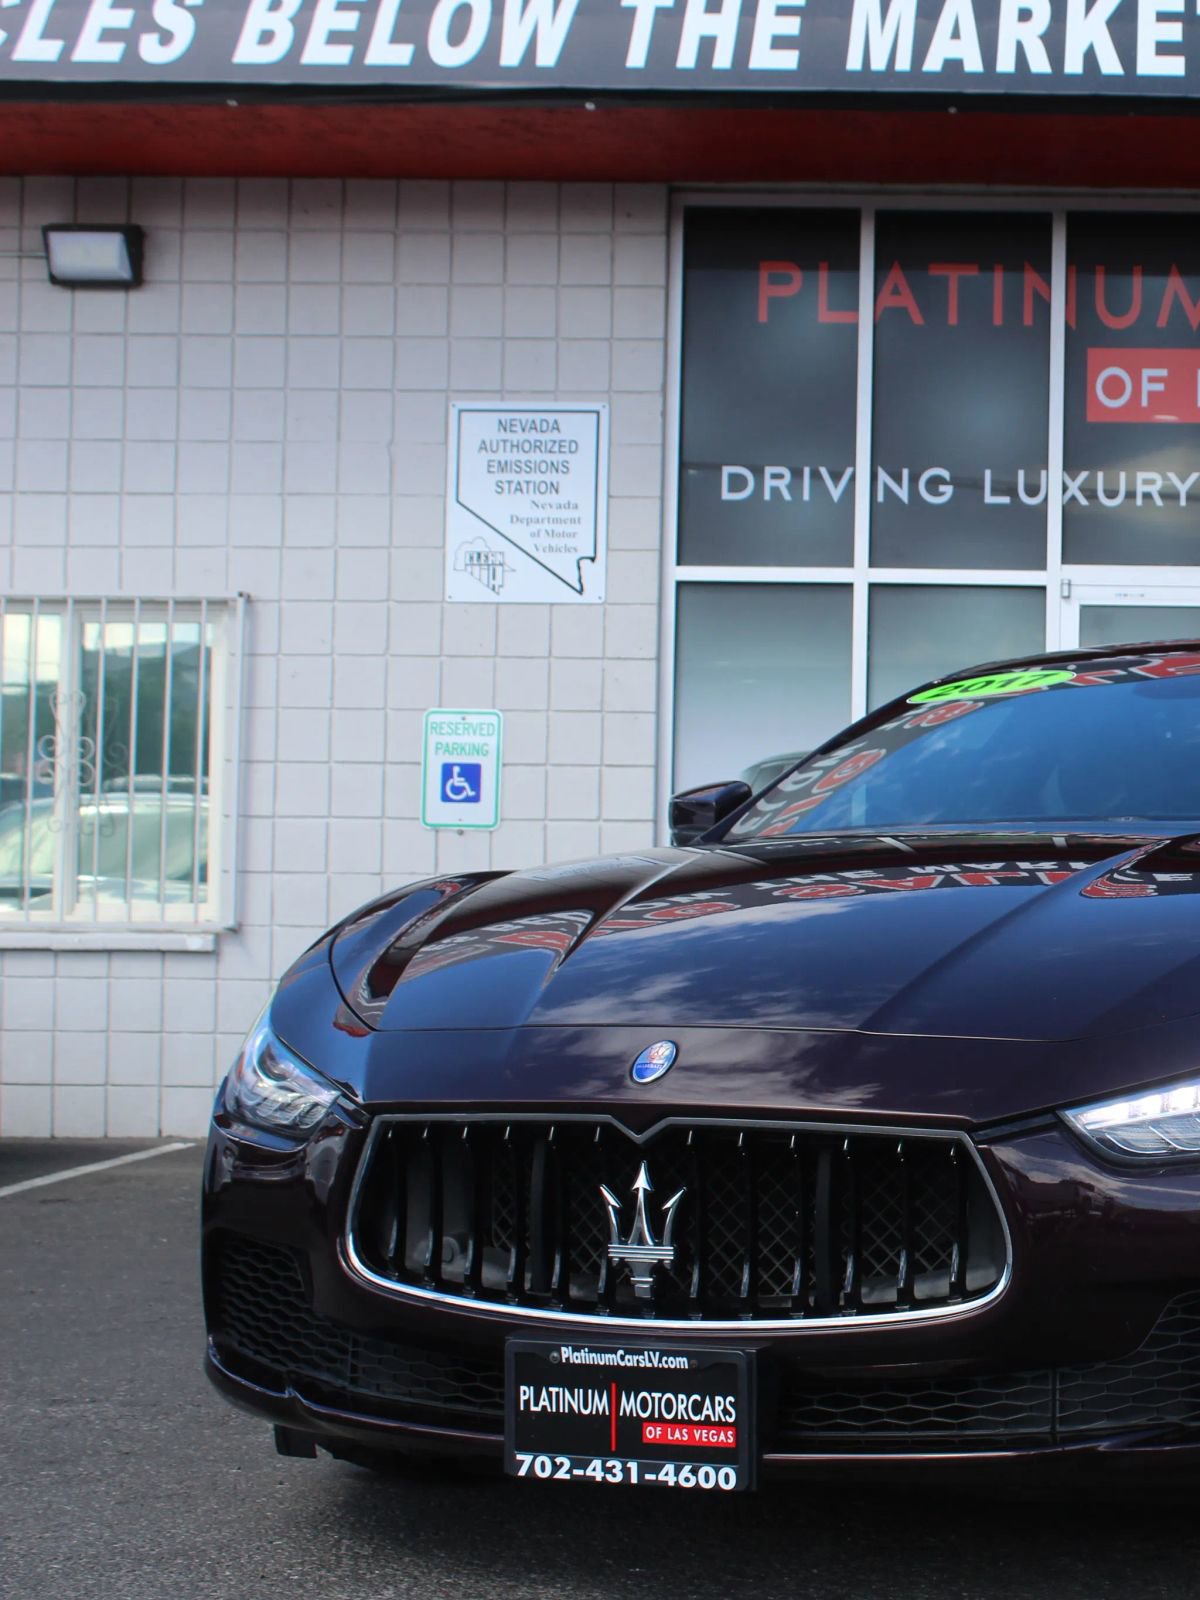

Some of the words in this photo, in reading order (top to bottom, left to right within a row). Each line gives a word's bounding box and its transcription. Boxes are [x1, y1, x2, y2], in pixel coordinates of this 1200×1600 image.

[0, 0, 197, 65] LES
[231, 0, 577, 68] BELOW
[620, 0, 806, 70] THE
[1095, 366, 1168, 409] OF
[497, 418, 561, 434] NEVADA
[478, 439, 579, 455] AUTHORIZED
[487, 459, 570, 475] EMISSIONS
[495, 480, 560, 495] STATION
[720, 465, 955, 505] DRIVNG
[983, 468, 1200, 508] LUXURY
[530, 500, 579, 511] Nevada
[510, 514, 582, 526] Department
[530, 529, 541, 539] of
[544, 529, 578, 539] Motor
[533, 543, 578, 553] Vehicles
[925, 672, 1062, 699] 2017
[430, 721, 496, 737] RESERVED
[435, 742, 489, 757] PARKING
[561, 1346, 689, 1370] PlatinumCarsLV.com
[519, 1385, 610, 1416] PLATINUM
[619, 1390, 737, 1423] MOTORCARS
[646, 1426, 663, 1439] OF
[667, 1427, 689, 1441] LAS
[693, 1429, 734, 1443] VEGAS
[515, 1453, 737, 1491] 702-431-4600
